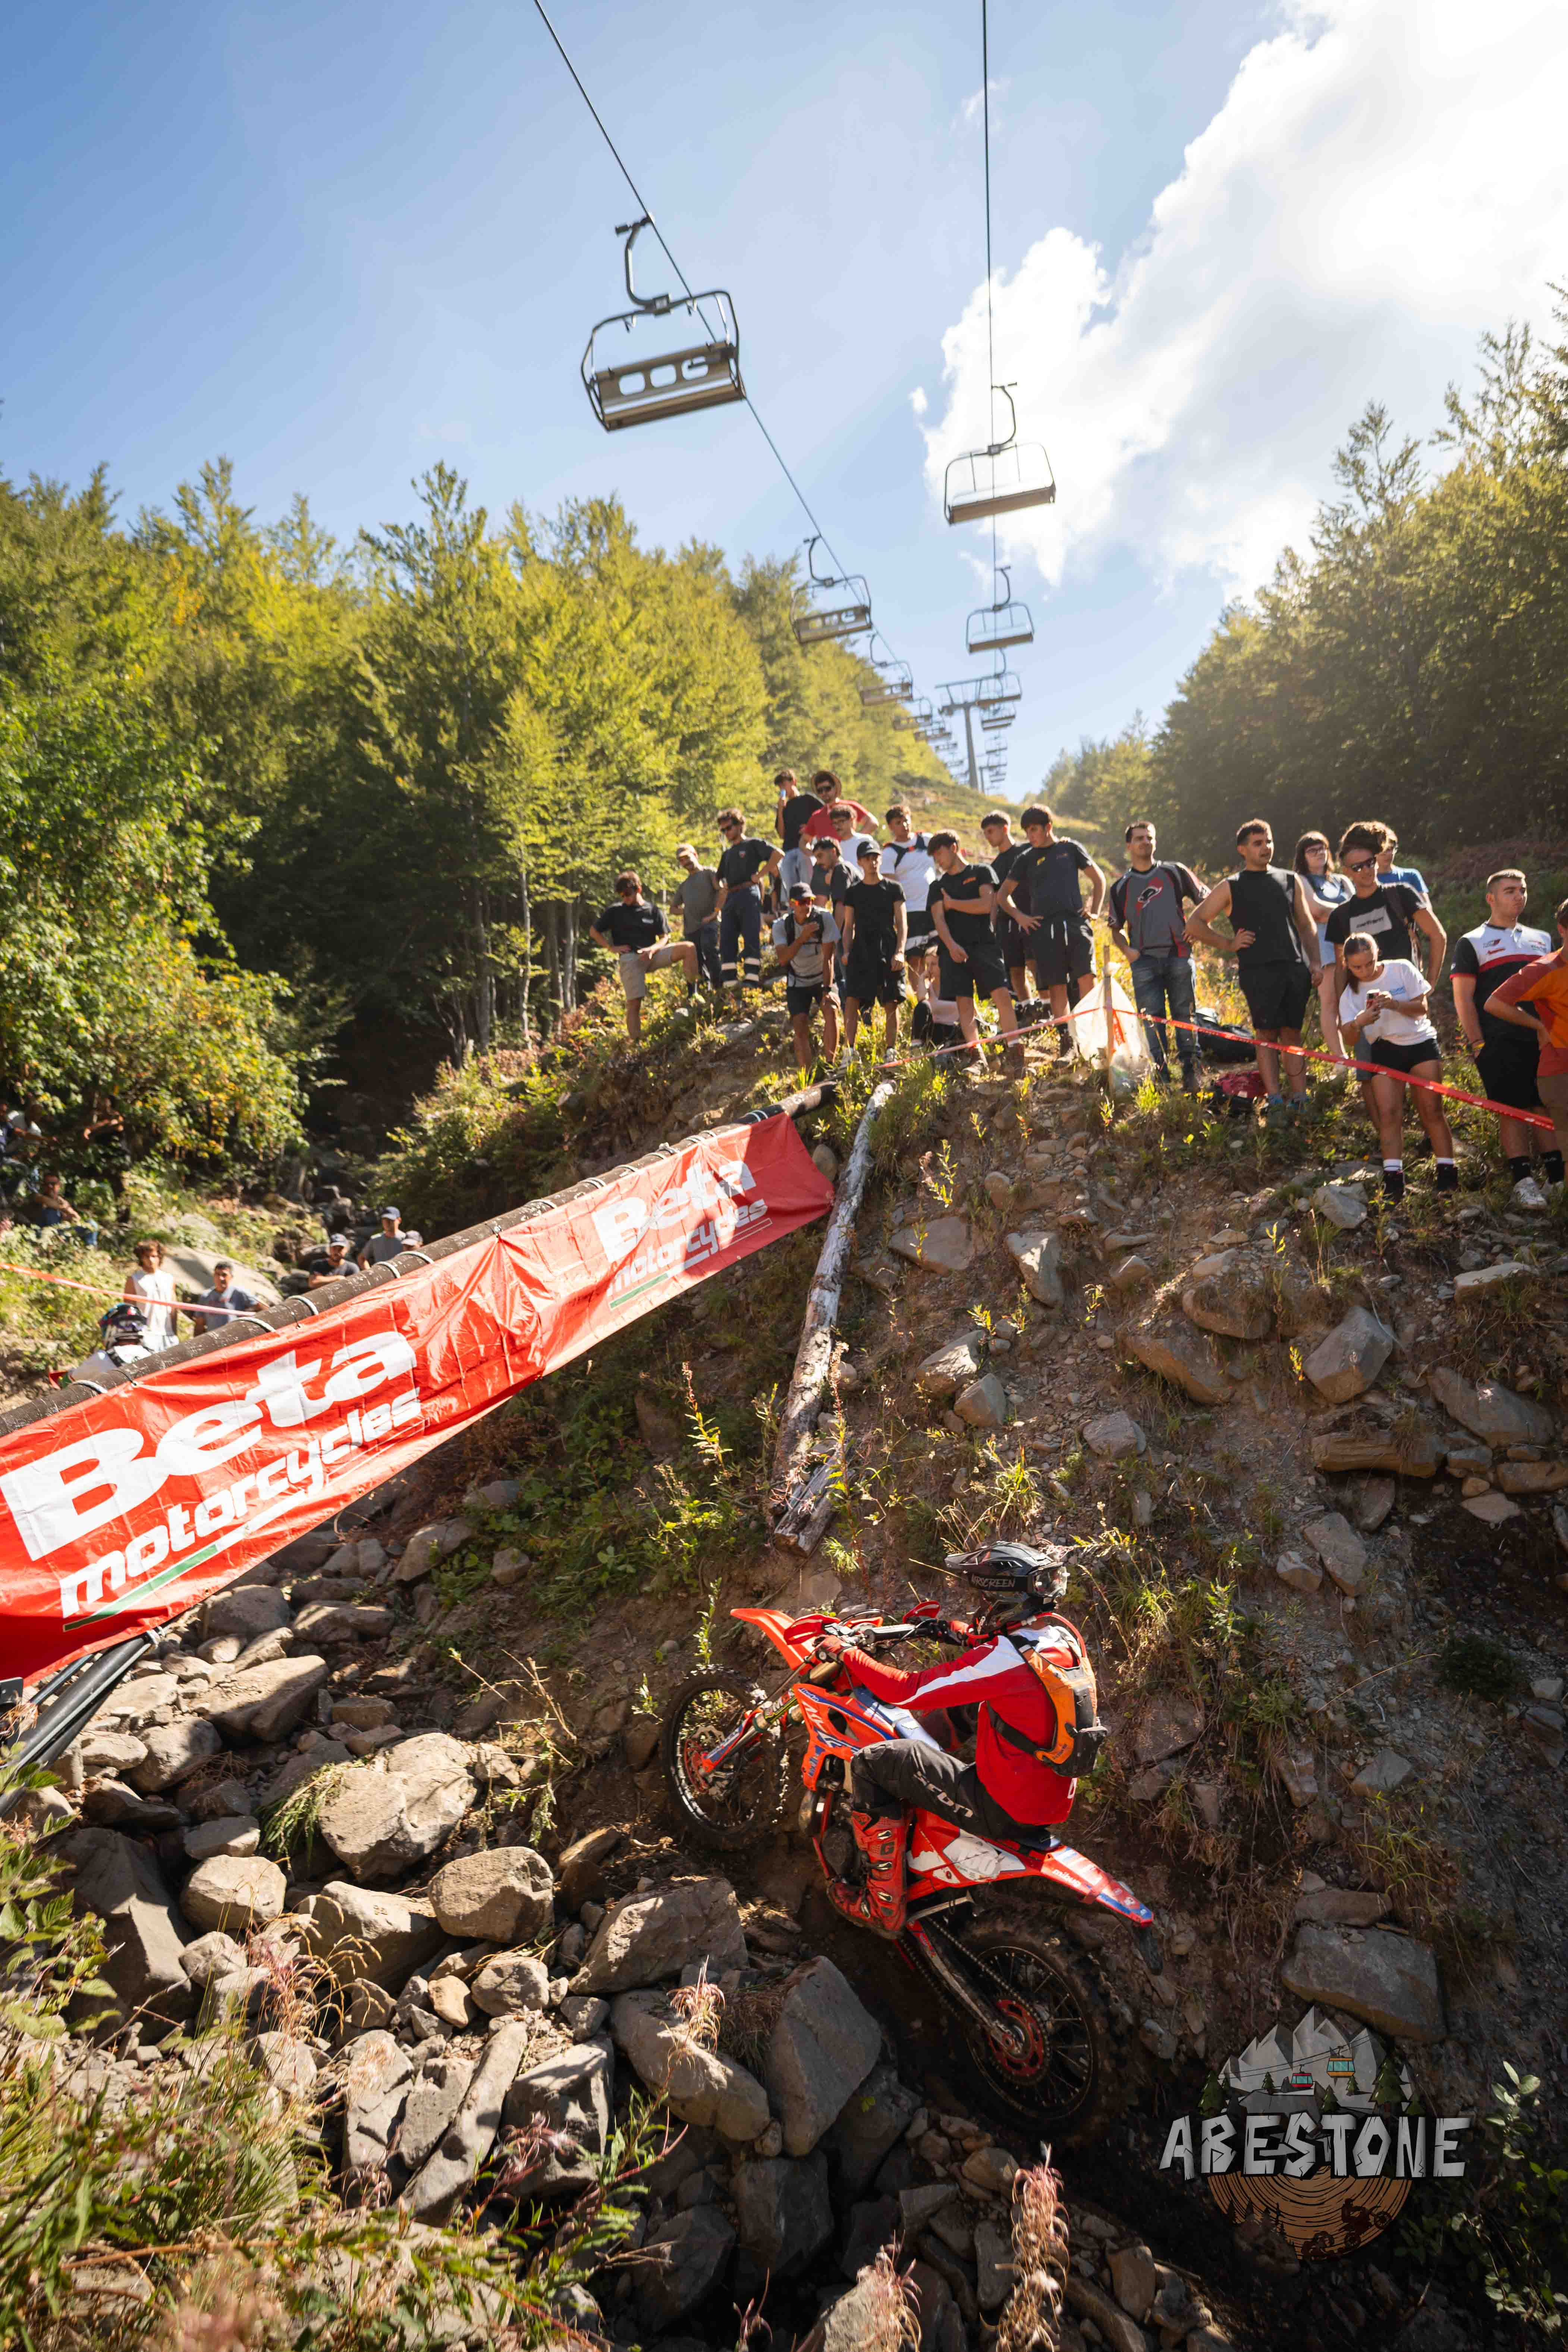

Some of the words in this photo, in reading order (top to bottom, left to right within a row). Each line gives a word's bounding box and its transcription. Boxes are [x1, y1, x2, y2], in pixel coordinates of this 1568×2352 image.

[591, 1160, 757, 1263] Beta
[607, 1199, 767, 1297] motorcycles
[0, 1331, 417, 1561] Beta
[60, 1387, 421, 1618] motorcycles
